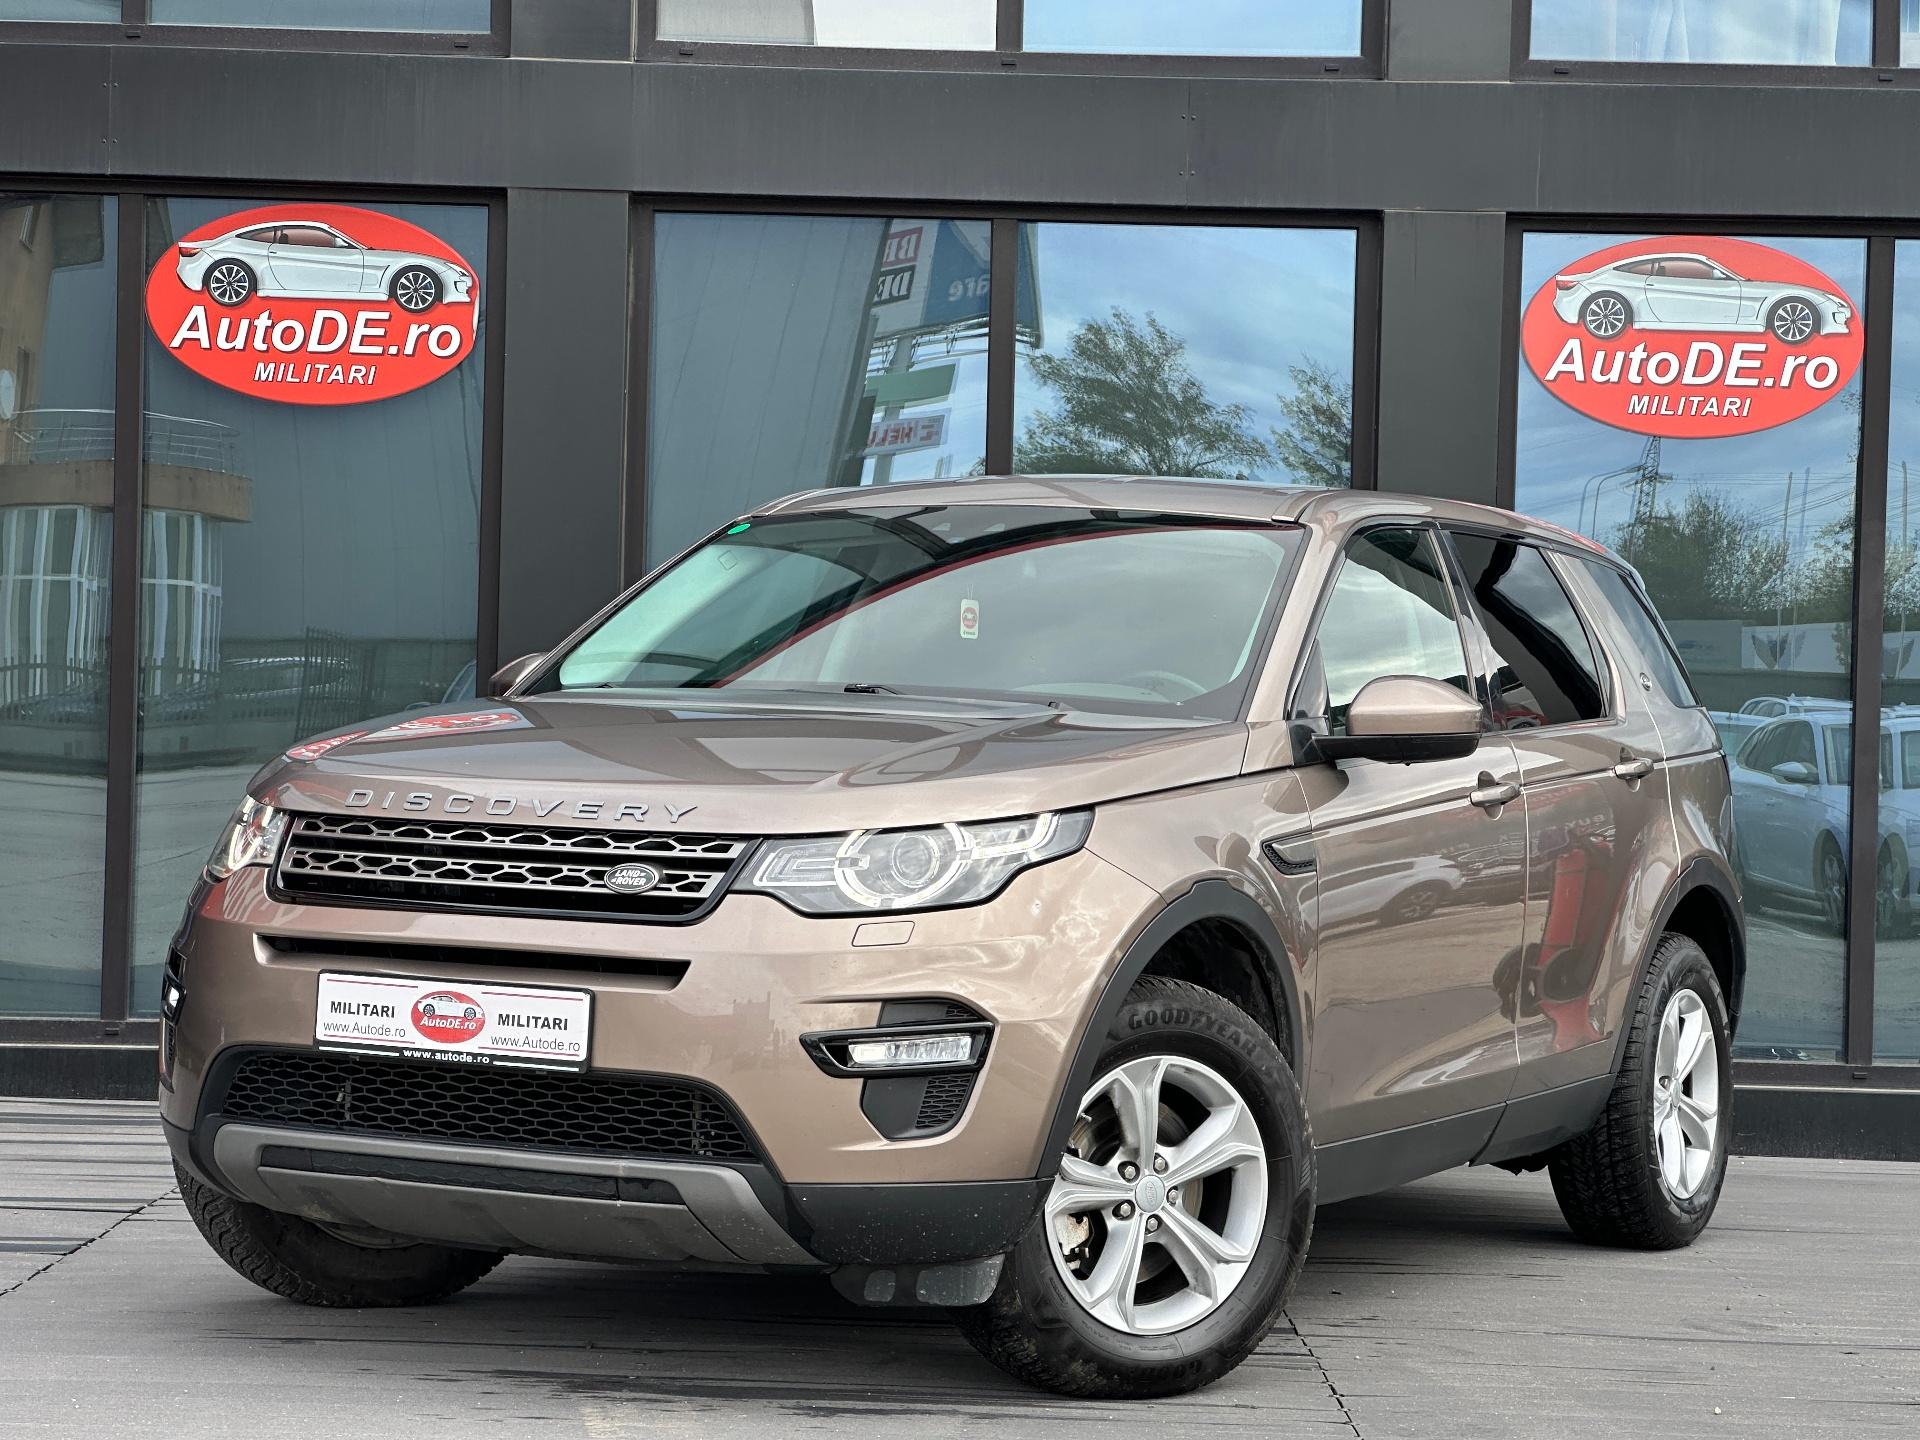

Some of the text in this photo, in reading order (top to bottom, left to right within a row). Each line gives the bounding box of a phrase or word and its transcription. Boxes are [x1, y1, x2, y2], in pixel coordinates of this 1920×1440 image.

[169, 304, 462, 358] AutoDE.ro
[1544, 338, 1840, 390] AutoDE.ro
[253, 362, 377, 386] MILITARI
[1628, 395, 1752, 417] MILITARI
[345, 789, 698, 823] DISCOVERY
[614, 869, 641, 878] LAND
[615, 876, 647, 886] ROVER
[330, 1001, 395, 1018] MILITARI
[323, 1021, 406, 1038] www.Autode.ro
[420, 1016, 477, 1031] AutoDE.ro
[498, 1013, 569, 1031] MILITARI
[491, 1034, 581, 1052] www.Autode.ro
[403, 1048, 490, 1064] www.autode.ro
